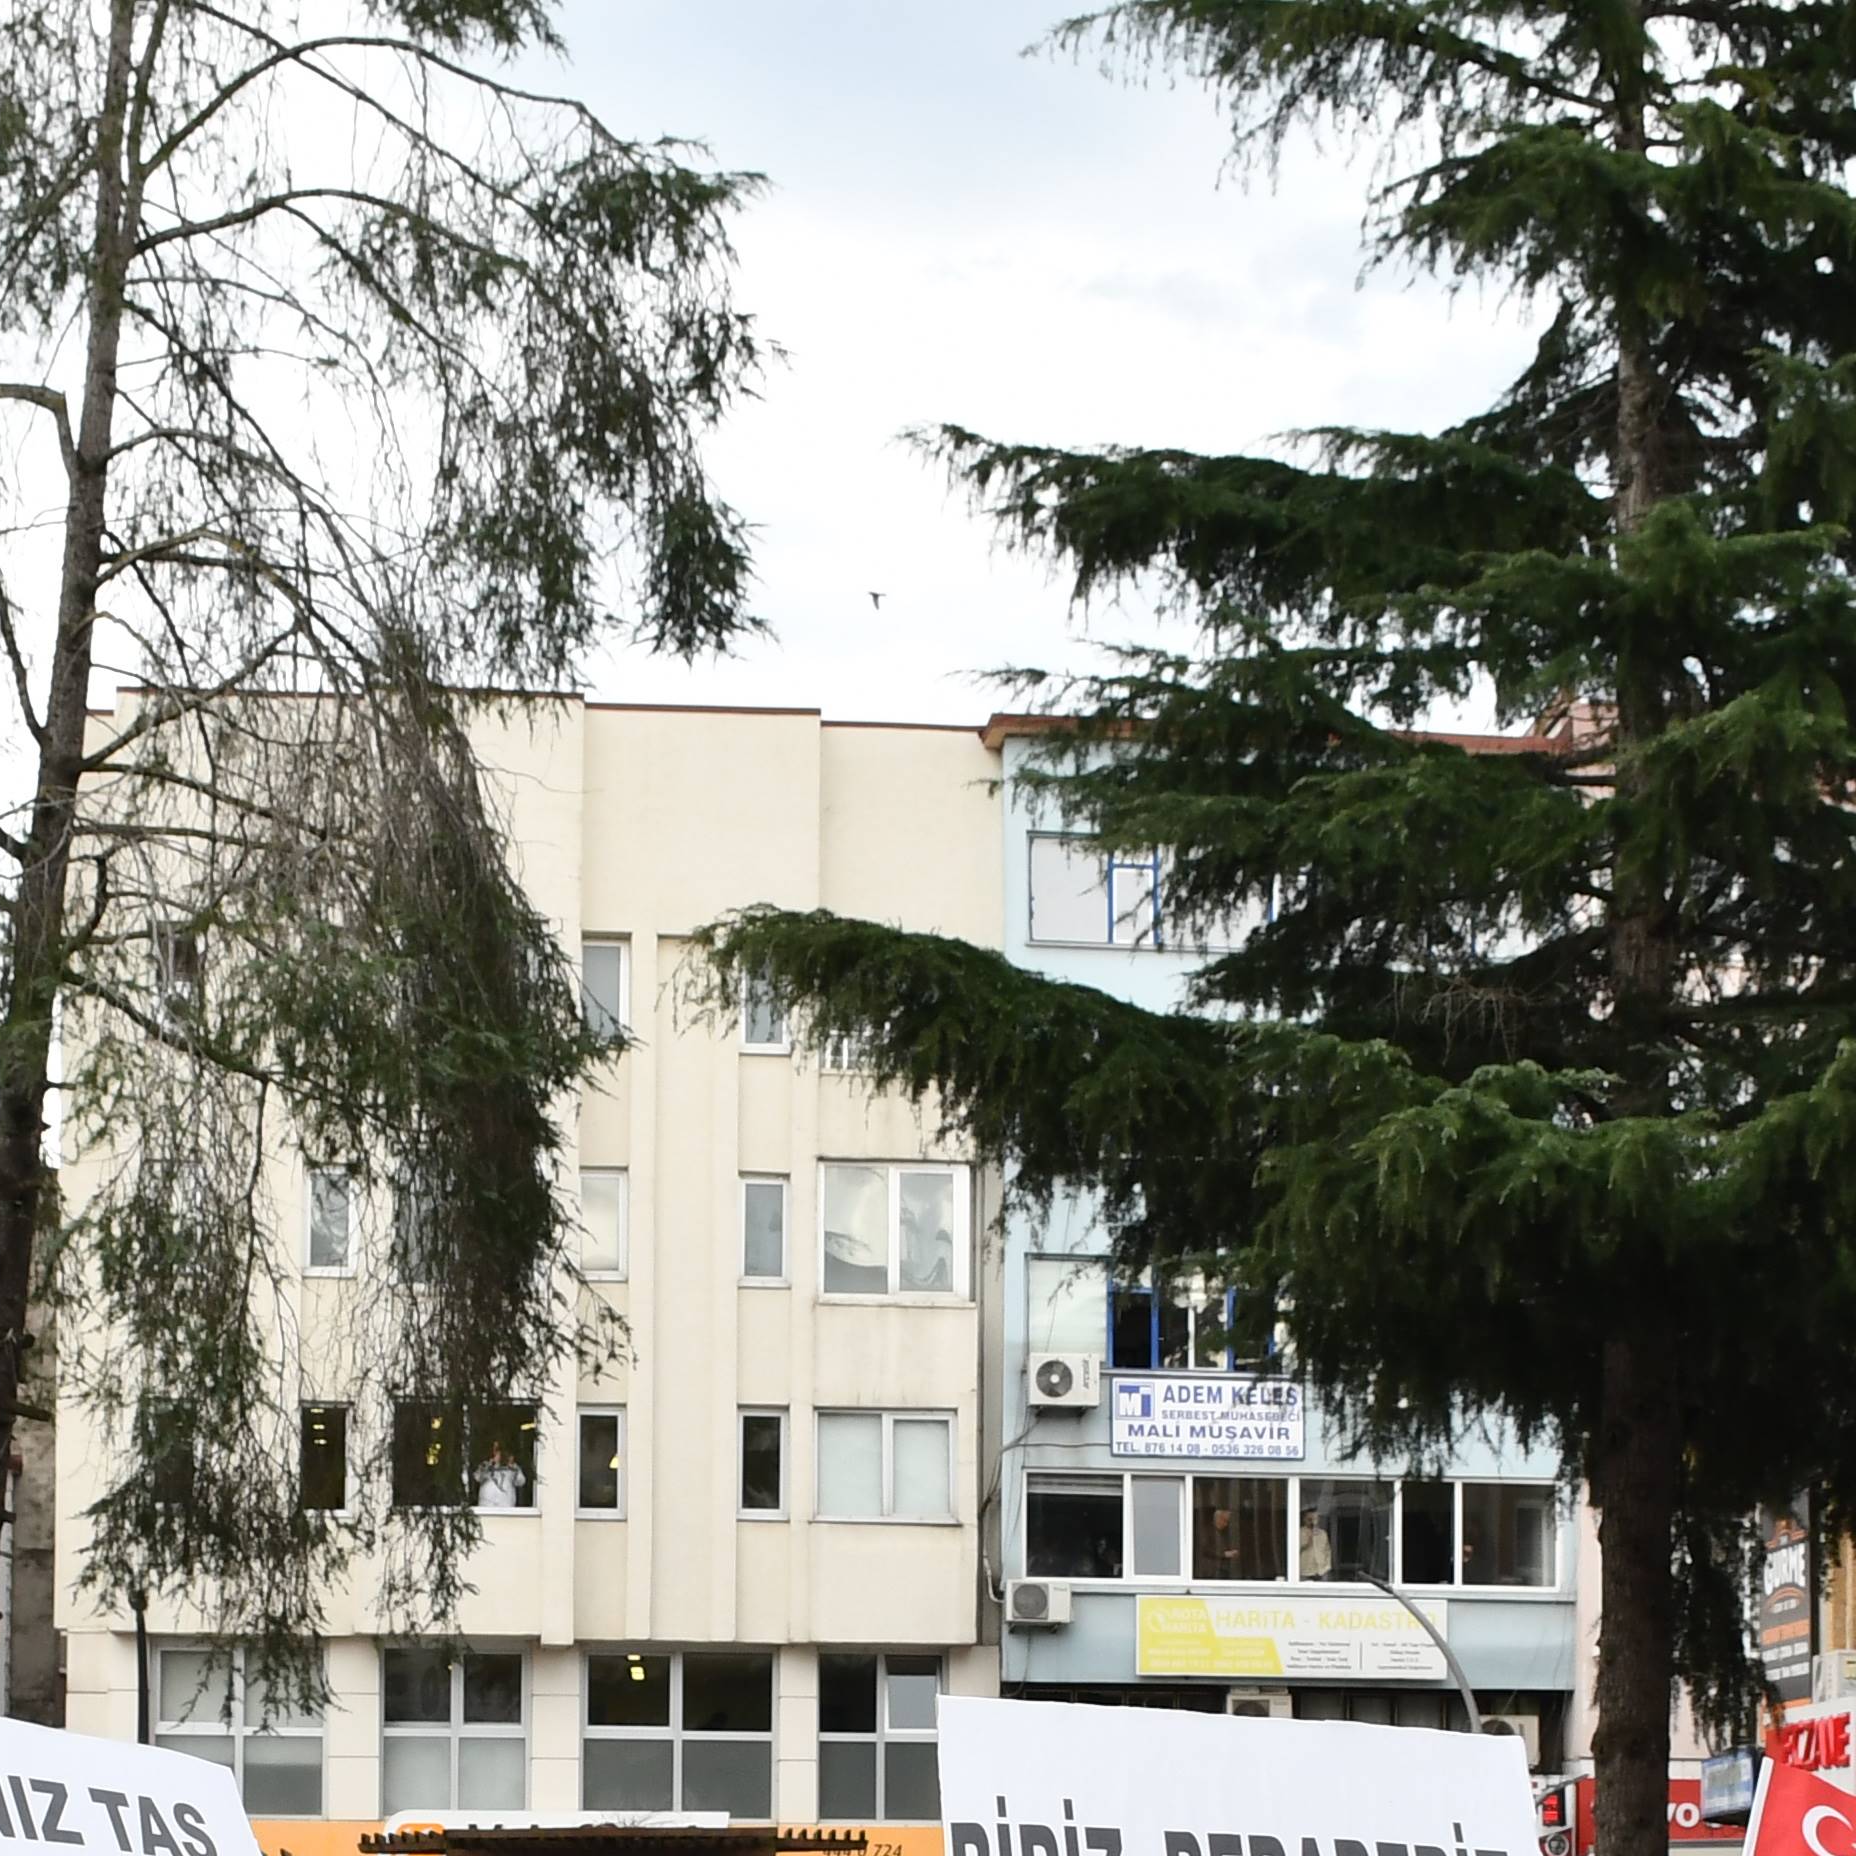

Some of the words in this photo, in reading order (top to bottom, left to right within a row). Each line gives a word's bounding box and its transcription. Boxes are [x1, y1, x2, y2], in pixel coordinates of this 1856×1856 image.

[1163, 1384, 1224, 1405] ADEM
[1162, 1409, 1216, 1421] SERBEST
[1127, 1422, 1181, 1438] MALİ
[1189, 1421, 1291, 1442] MÜŞAVİR
